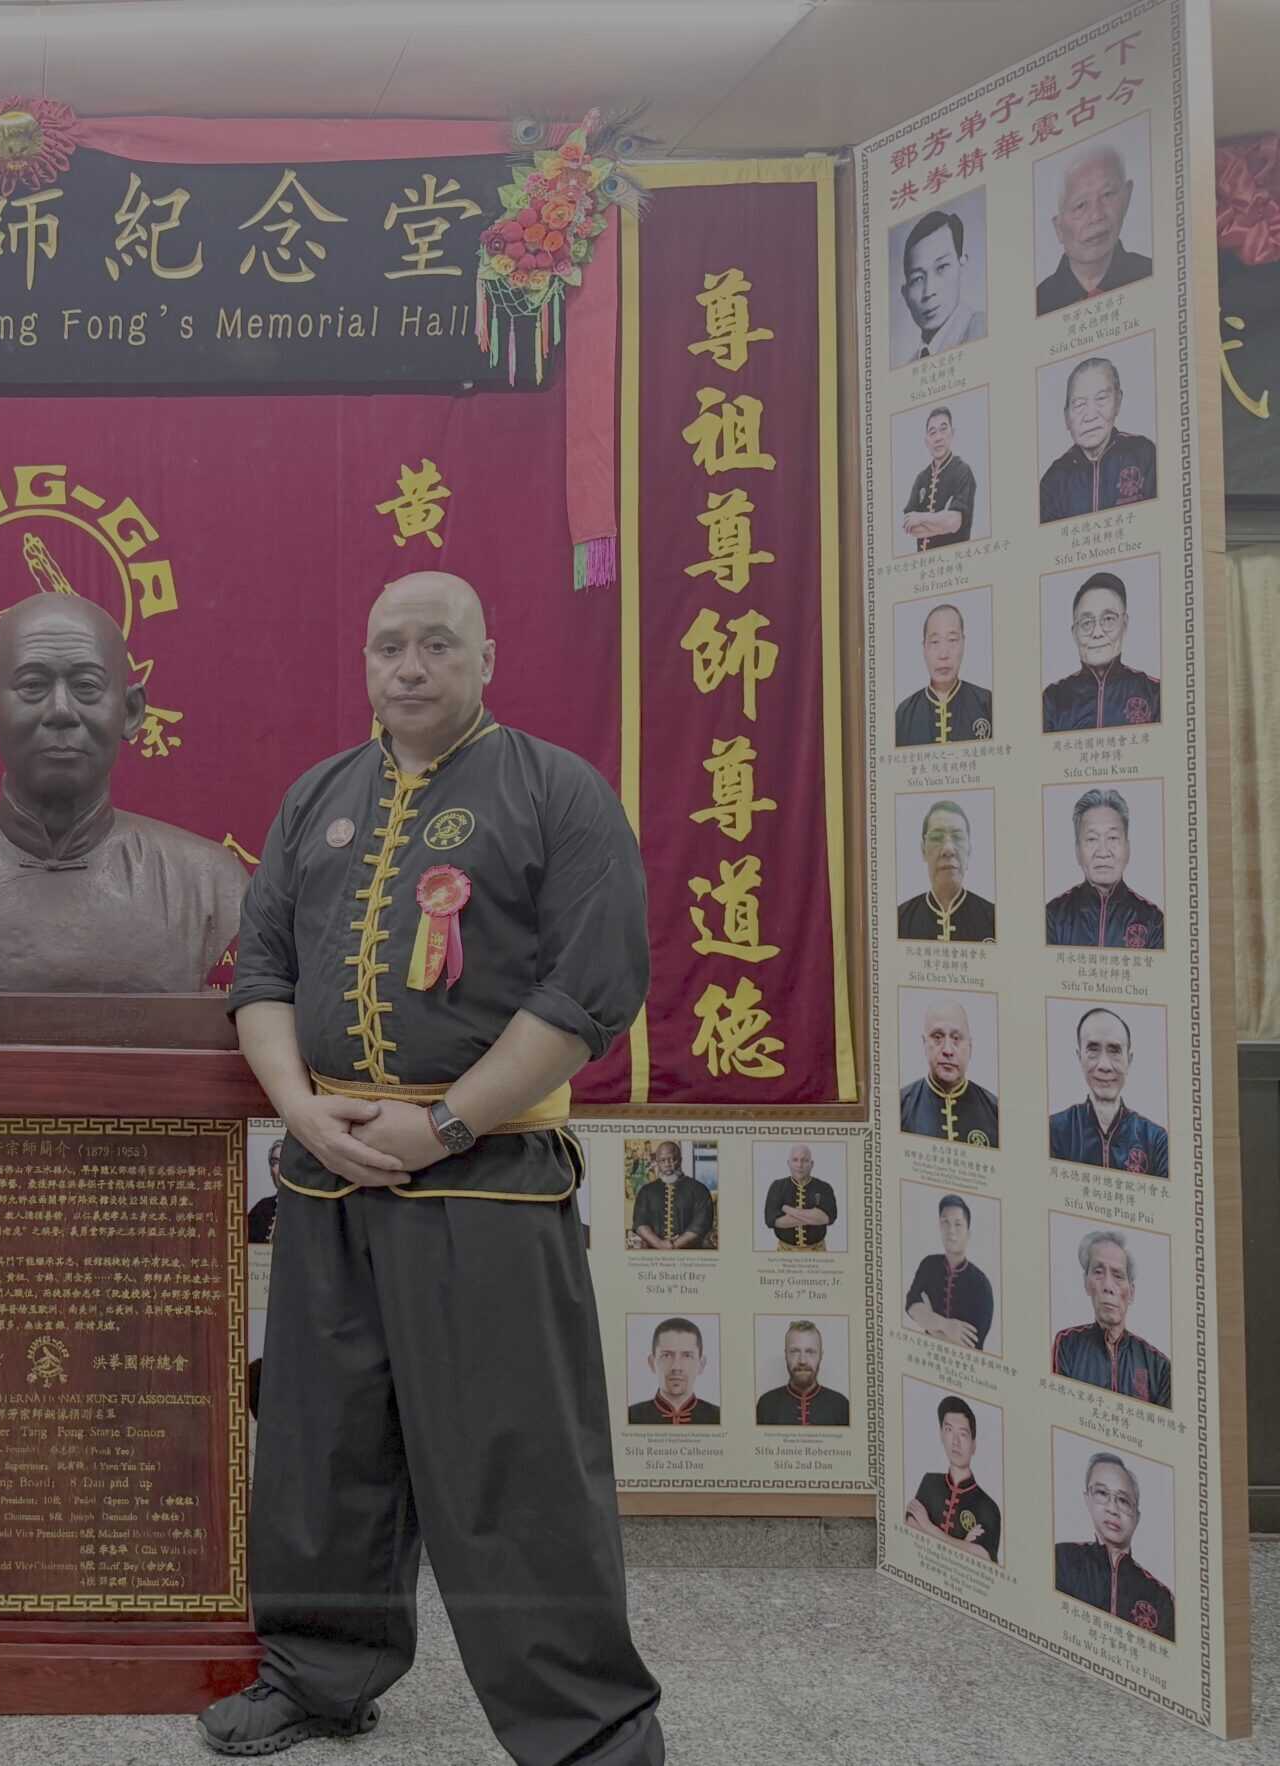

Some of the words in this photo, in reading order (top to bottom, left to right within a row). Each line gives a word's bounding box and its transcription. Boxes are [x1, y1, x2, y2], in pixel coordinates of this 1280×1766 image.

[888, 30, 1143, 175] 鄧芳弟子遍天下
[889, 76, 1144, 210] 洪拳精華震古今
[63, 304, 194, 346] Fong's
[215, 305, 379, 339] Memorial
[400, 305, 470, 337] Hall
[1055, 552, 1074, 566] Sifu
[1089, 546, 1116, 559] Moon
[680, 269, 786, 1078] 尊祖尊師尊道德
[1064, 767, 1083, 779] Sifu
[1110, 764, 1139, 776] Kwan
[1061, 981, 1081, 992] Sifu
[1096, 982, 1123, 994] Moon
[1124, 984, 1149, 996] Choi
[1064, 1197, 1085, 1211] Sifu
[1086, 1200, 1113, 1216] Wong
[1114, 1206, 1136, 1223] Ping
[1138, 1210, 1155, 1225] Pui
[638, 1271, 656, 1281] Sifu
[646, 1285, 664, 1295] Sifu
[680, 1285, 698, 1295] Dan
[774, 1290, 793, 1300] Sifu
[808, 1290, 827, 1300] Dan
[86, 1393, 118, 1405] KUNG
[120, 1393, 136, 1405] FU
[138, 1393, 212, 1405] ASSOCIATION
[1079, 1416, 1098, 1431] Sifu
[21, 1426, 48, 1439] Tang
[57, 1426, 85, 1440] Fong
[127, 1426, 166, 1438] Donors
[625, 1446, 644, 1457] Sifu
[754, 1446, 774, 1457] Sifu
[645, 1460, 664, 1470] Sifu
[666, 1460, 683, 1470] 2nd
[685, 1460, 704, 1470] Dan
[774, 1460, 792, 1470] Sifu
[794, 1460, 812, 1470] 2nd
[814, 1460, 833, 1470] Dan
[83, 1477, 105, 1488] Dan
[110, 1477, 129, 1489] and
[1063, 1630, 1082, 1647] Sifu
[1100, 1646, 1122, 1664] Rick
[1142, 1665, 1167, 1690] Fung
